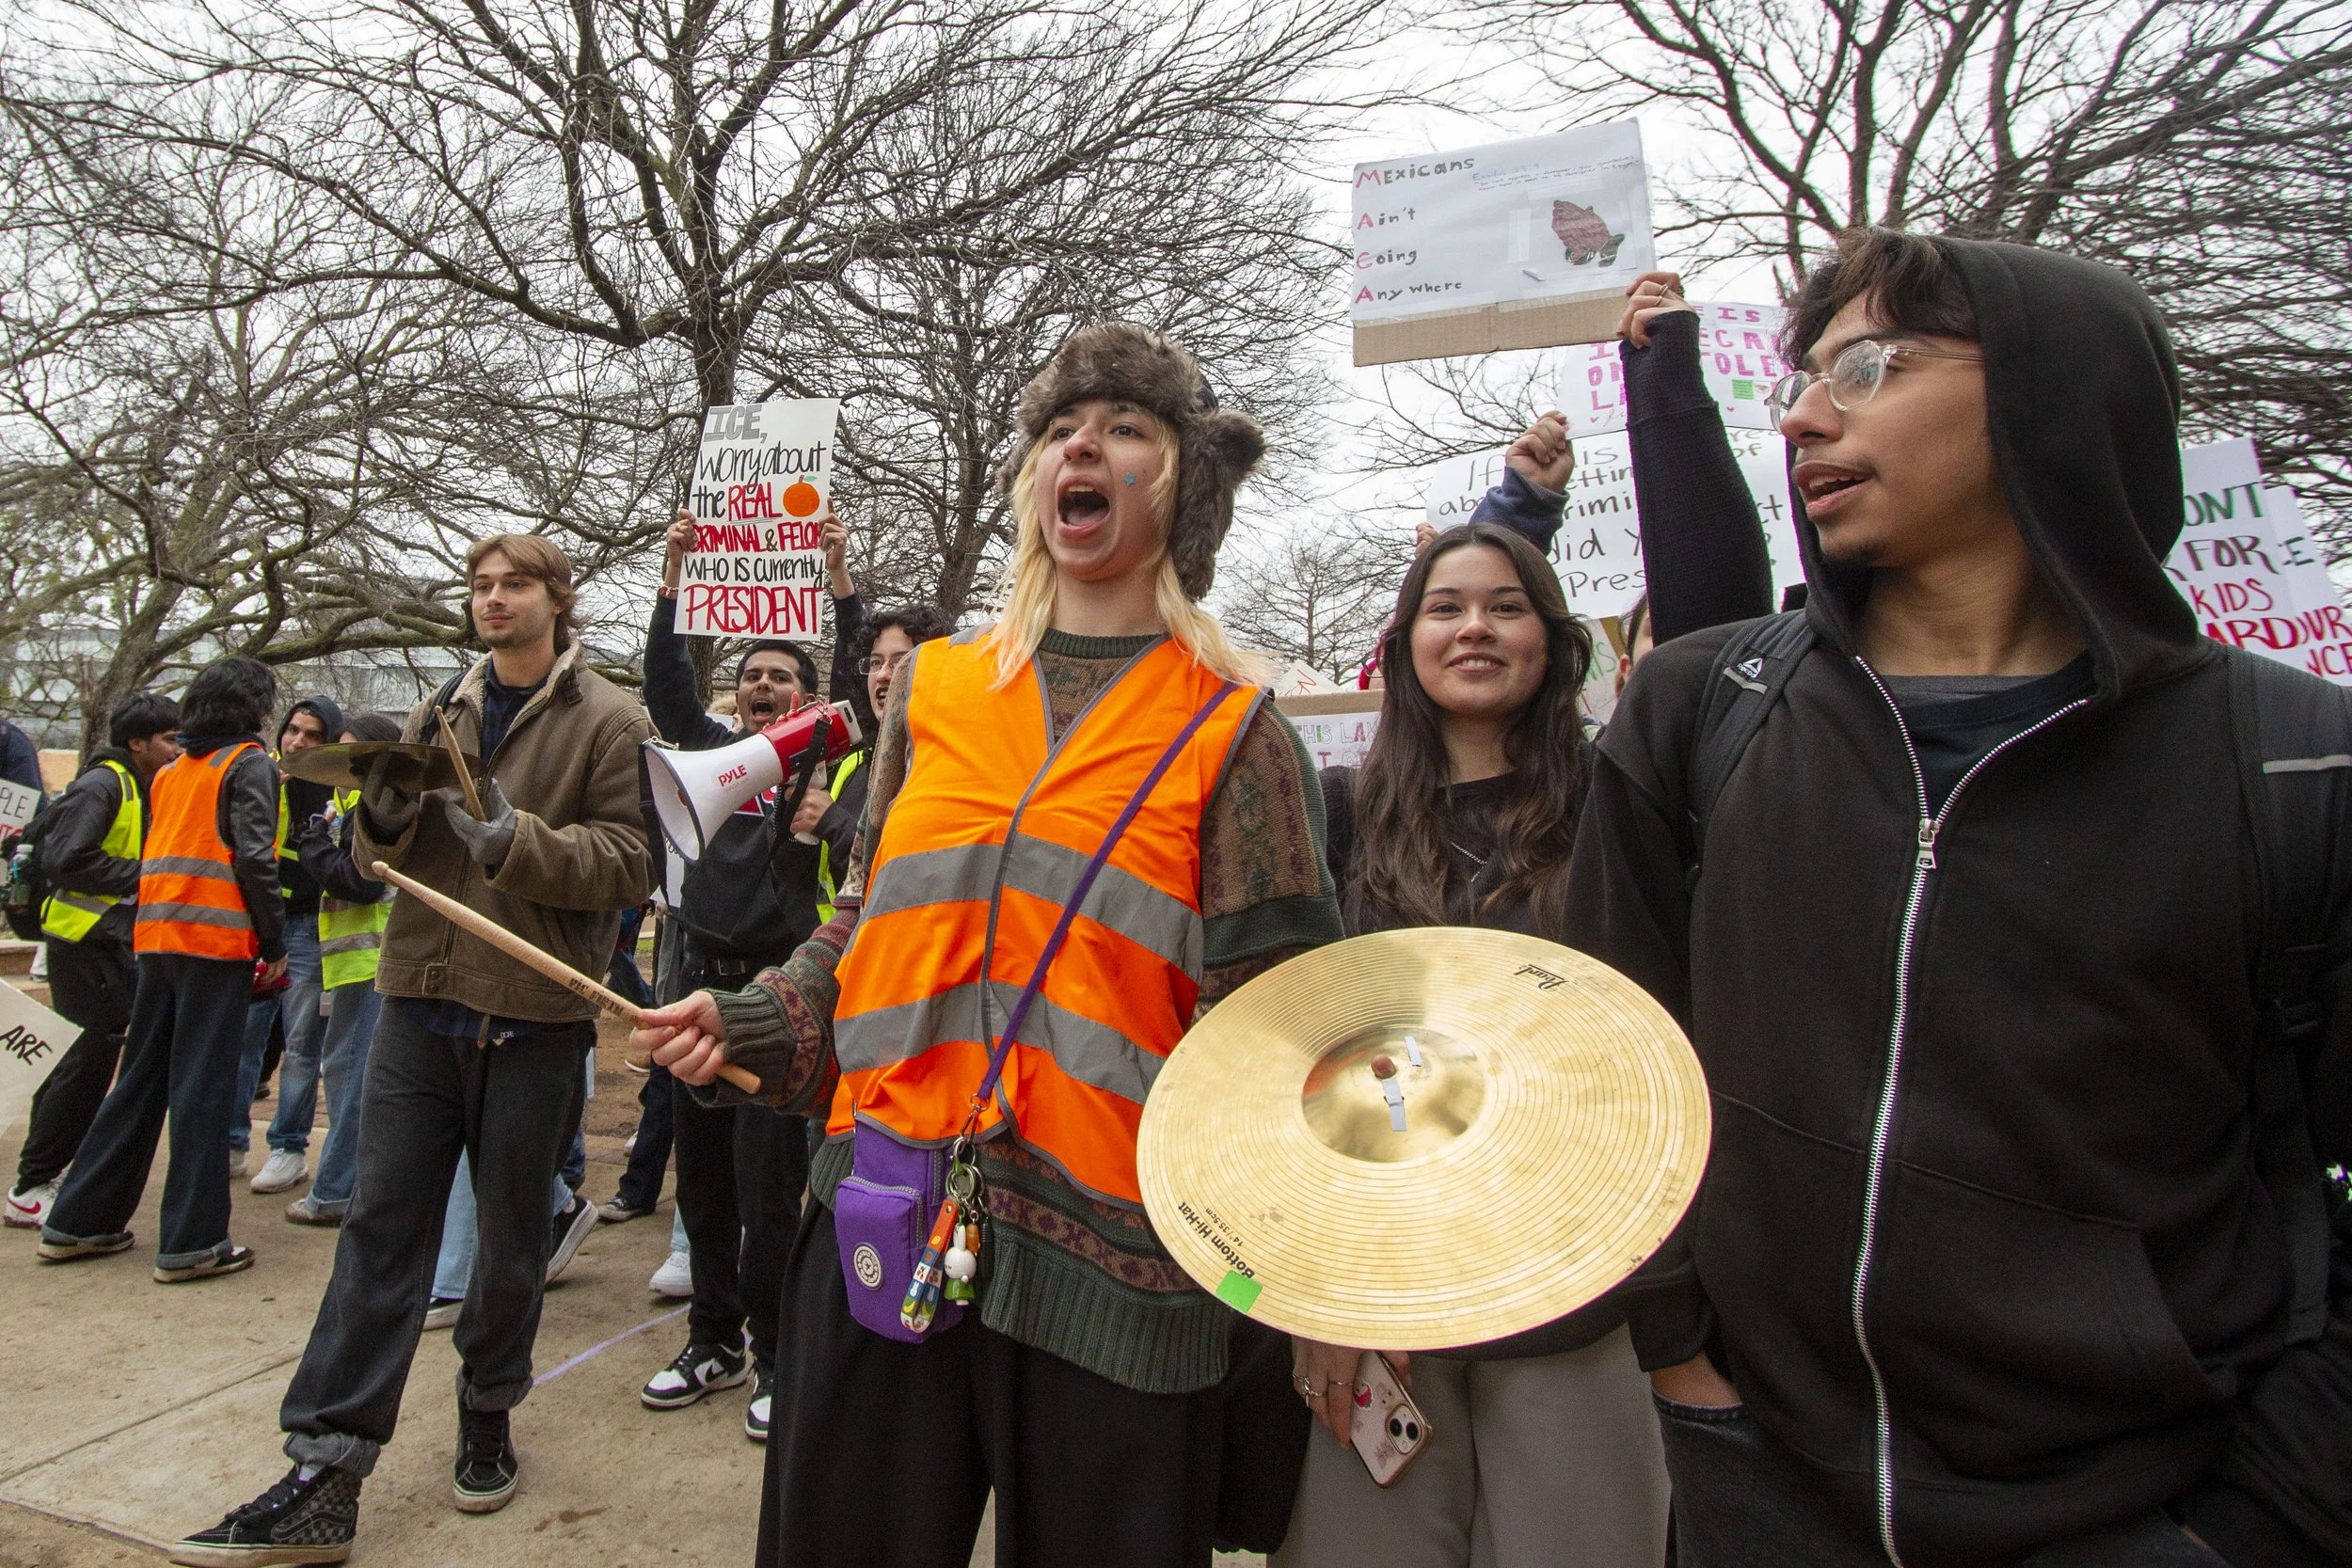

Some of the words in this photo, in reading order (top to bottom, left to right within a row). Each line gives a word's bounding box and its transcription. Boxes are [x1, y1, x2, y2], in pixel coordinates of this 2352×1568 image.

[1357, 207, 1416, 230] Ain't
[704, 404, 768, 444] ICE,
[762, 440, 827, 476] about
[691, 484, 726, 518] the
[728, 481, 783, 521] REAL
[765, 529, 779, 553] &
[2183, 535, 2280, 575] FOR
[684, 555, 729, 582] WHO
[735, 557, 750, 582] IS
[683, 583, 824, 635] PRESIDENT
[2189, 578, 2274, 620] KIDS
[1296, 723, 1333, 745] HIS
[718, 764, 748, 787] PYLE
[0, 1024, 54, 1066] ARE
[1178, 1201, 1213, 1238] Hi-Hat
[1211, 1235, 1255, 1278] Bottom
